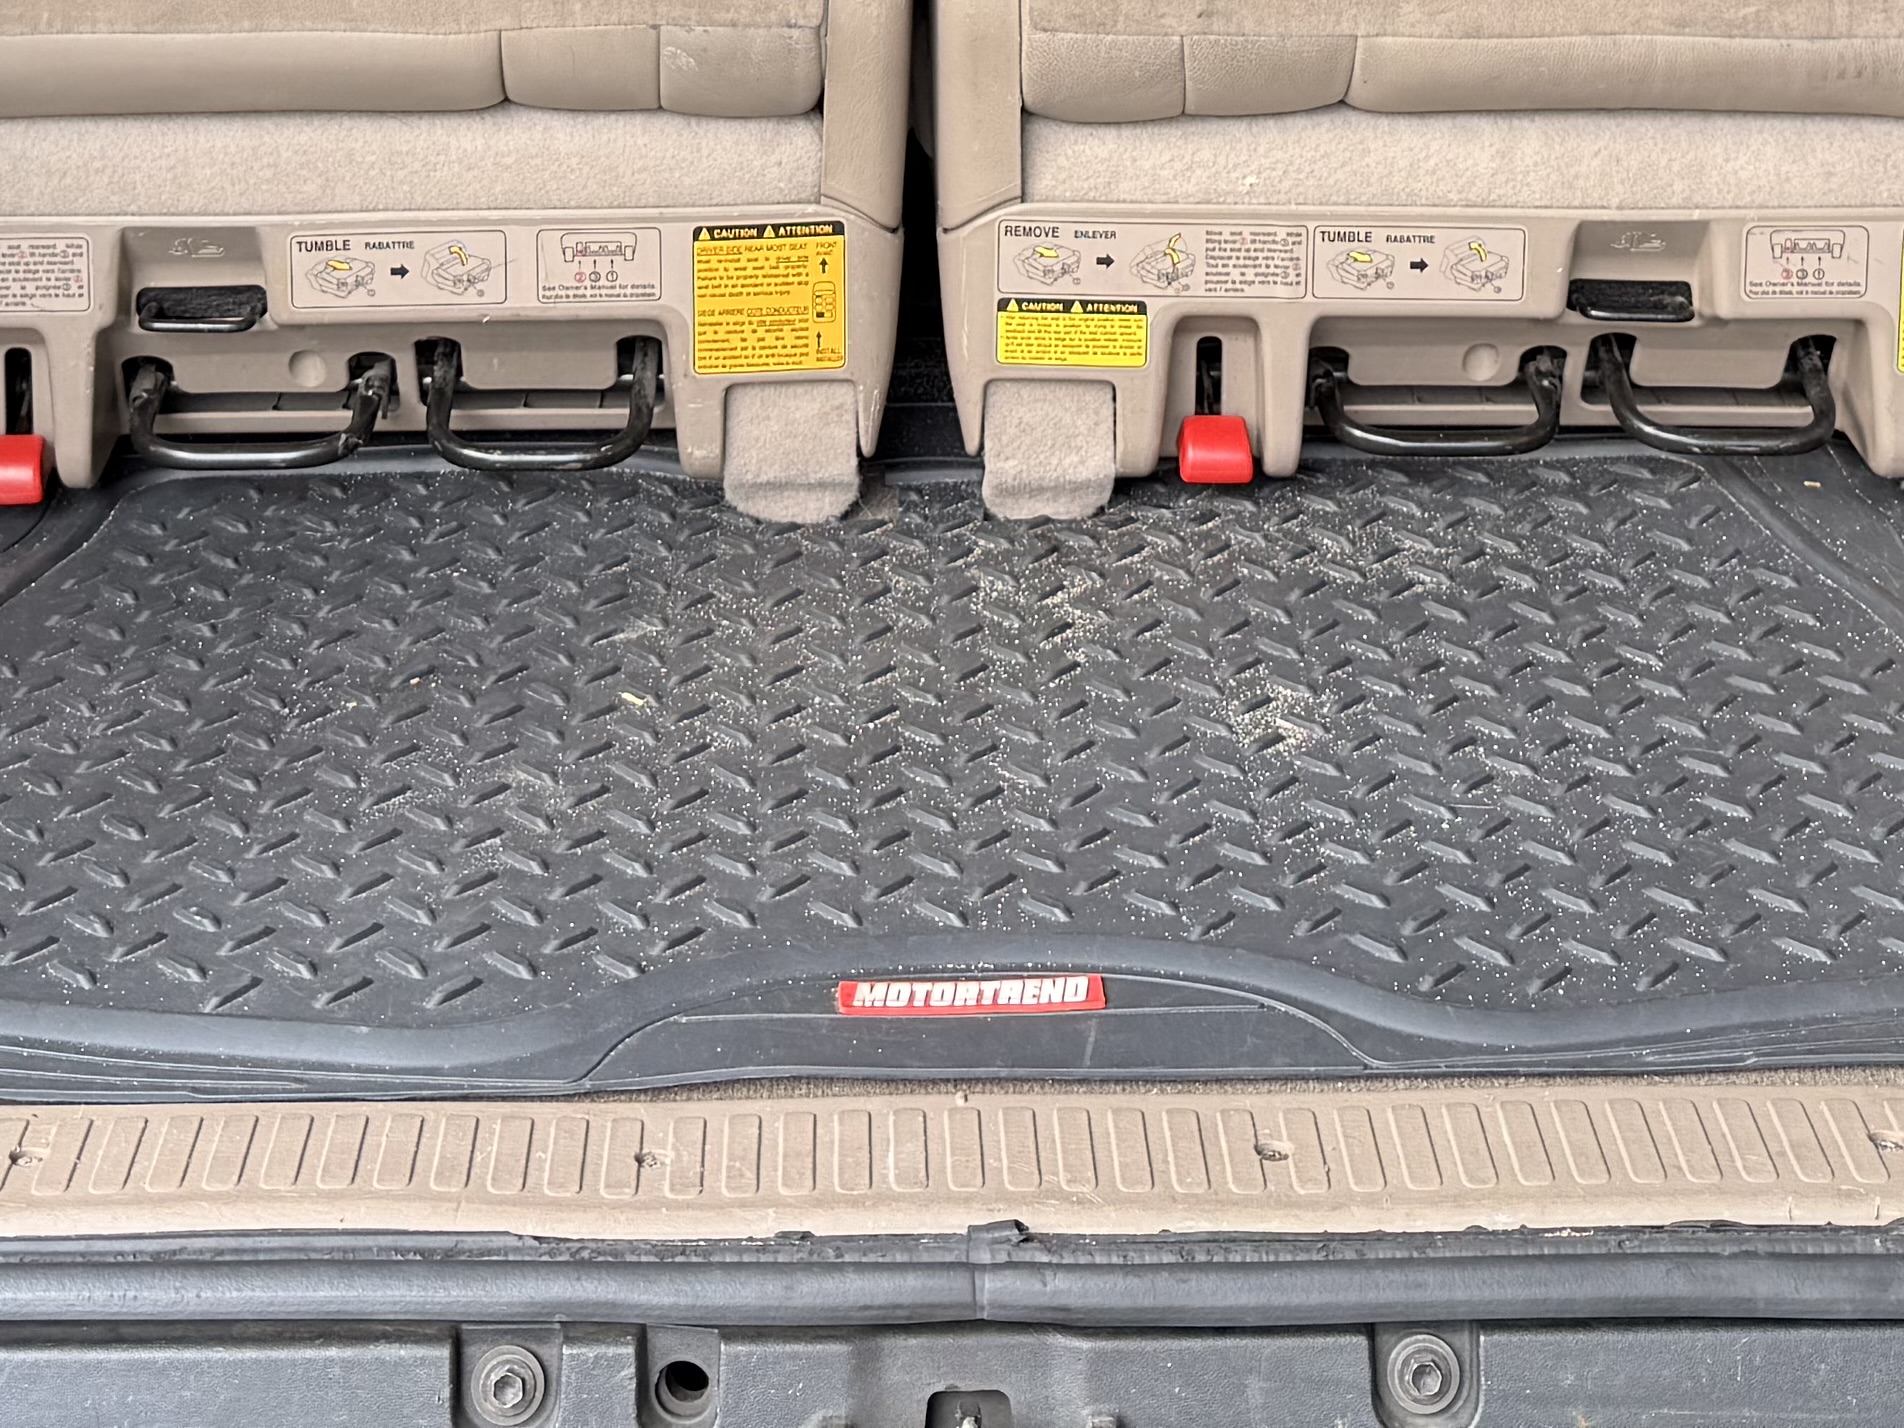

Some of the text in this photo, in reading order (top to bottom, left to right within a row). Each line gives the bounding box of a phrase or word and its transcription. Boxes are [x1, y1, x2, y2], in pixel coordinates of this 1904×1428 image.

[713, 224, 834, 238] CAUTION ATTENTION
[1004, 225, 1117, 239] REMOVE ENLEVER
[1319, 231, 1436, 244] TUMBLE RABATTRE
[296, 239, 415, 252] TUMBLE RABATTRE
[1022, 302, 1138, 313] CAUTION ATTENTION
[852, 976, 1089, 1007] MOTORTREND
